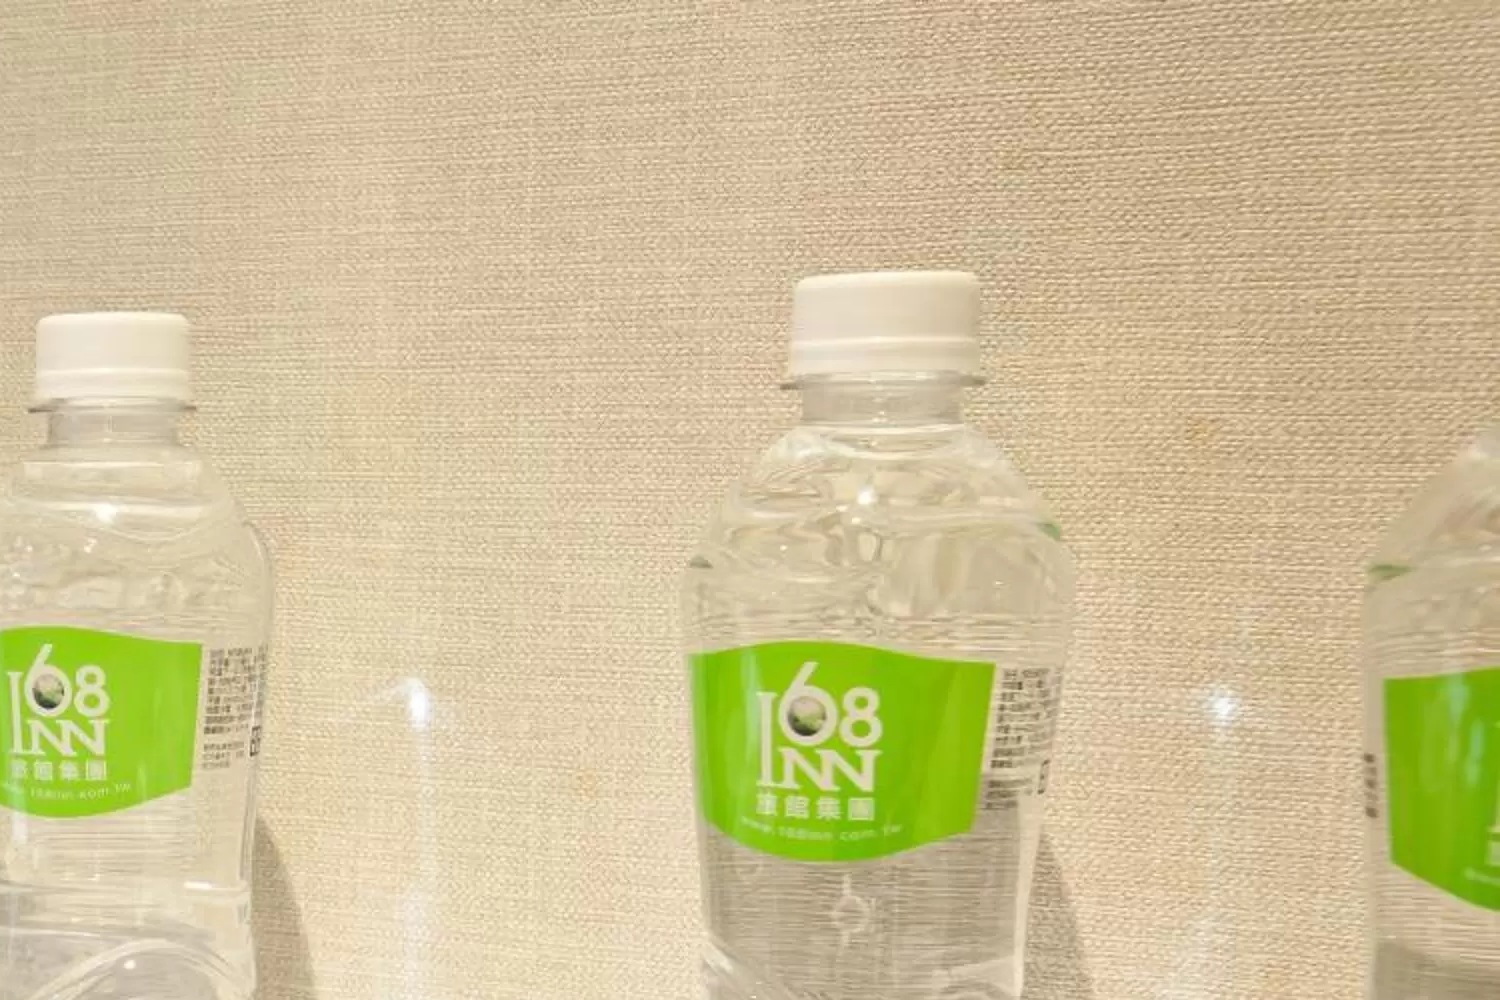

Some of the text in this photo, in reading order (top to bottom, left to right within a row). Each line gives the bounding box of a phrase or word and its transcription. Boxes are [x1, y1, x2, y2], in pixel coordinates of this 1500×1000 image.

[7, 644, 110, 717] 168
[756, 661, 883, 747] 168
[7, 706, 110, 757] INN
[756, 736, 882, 792] INN
